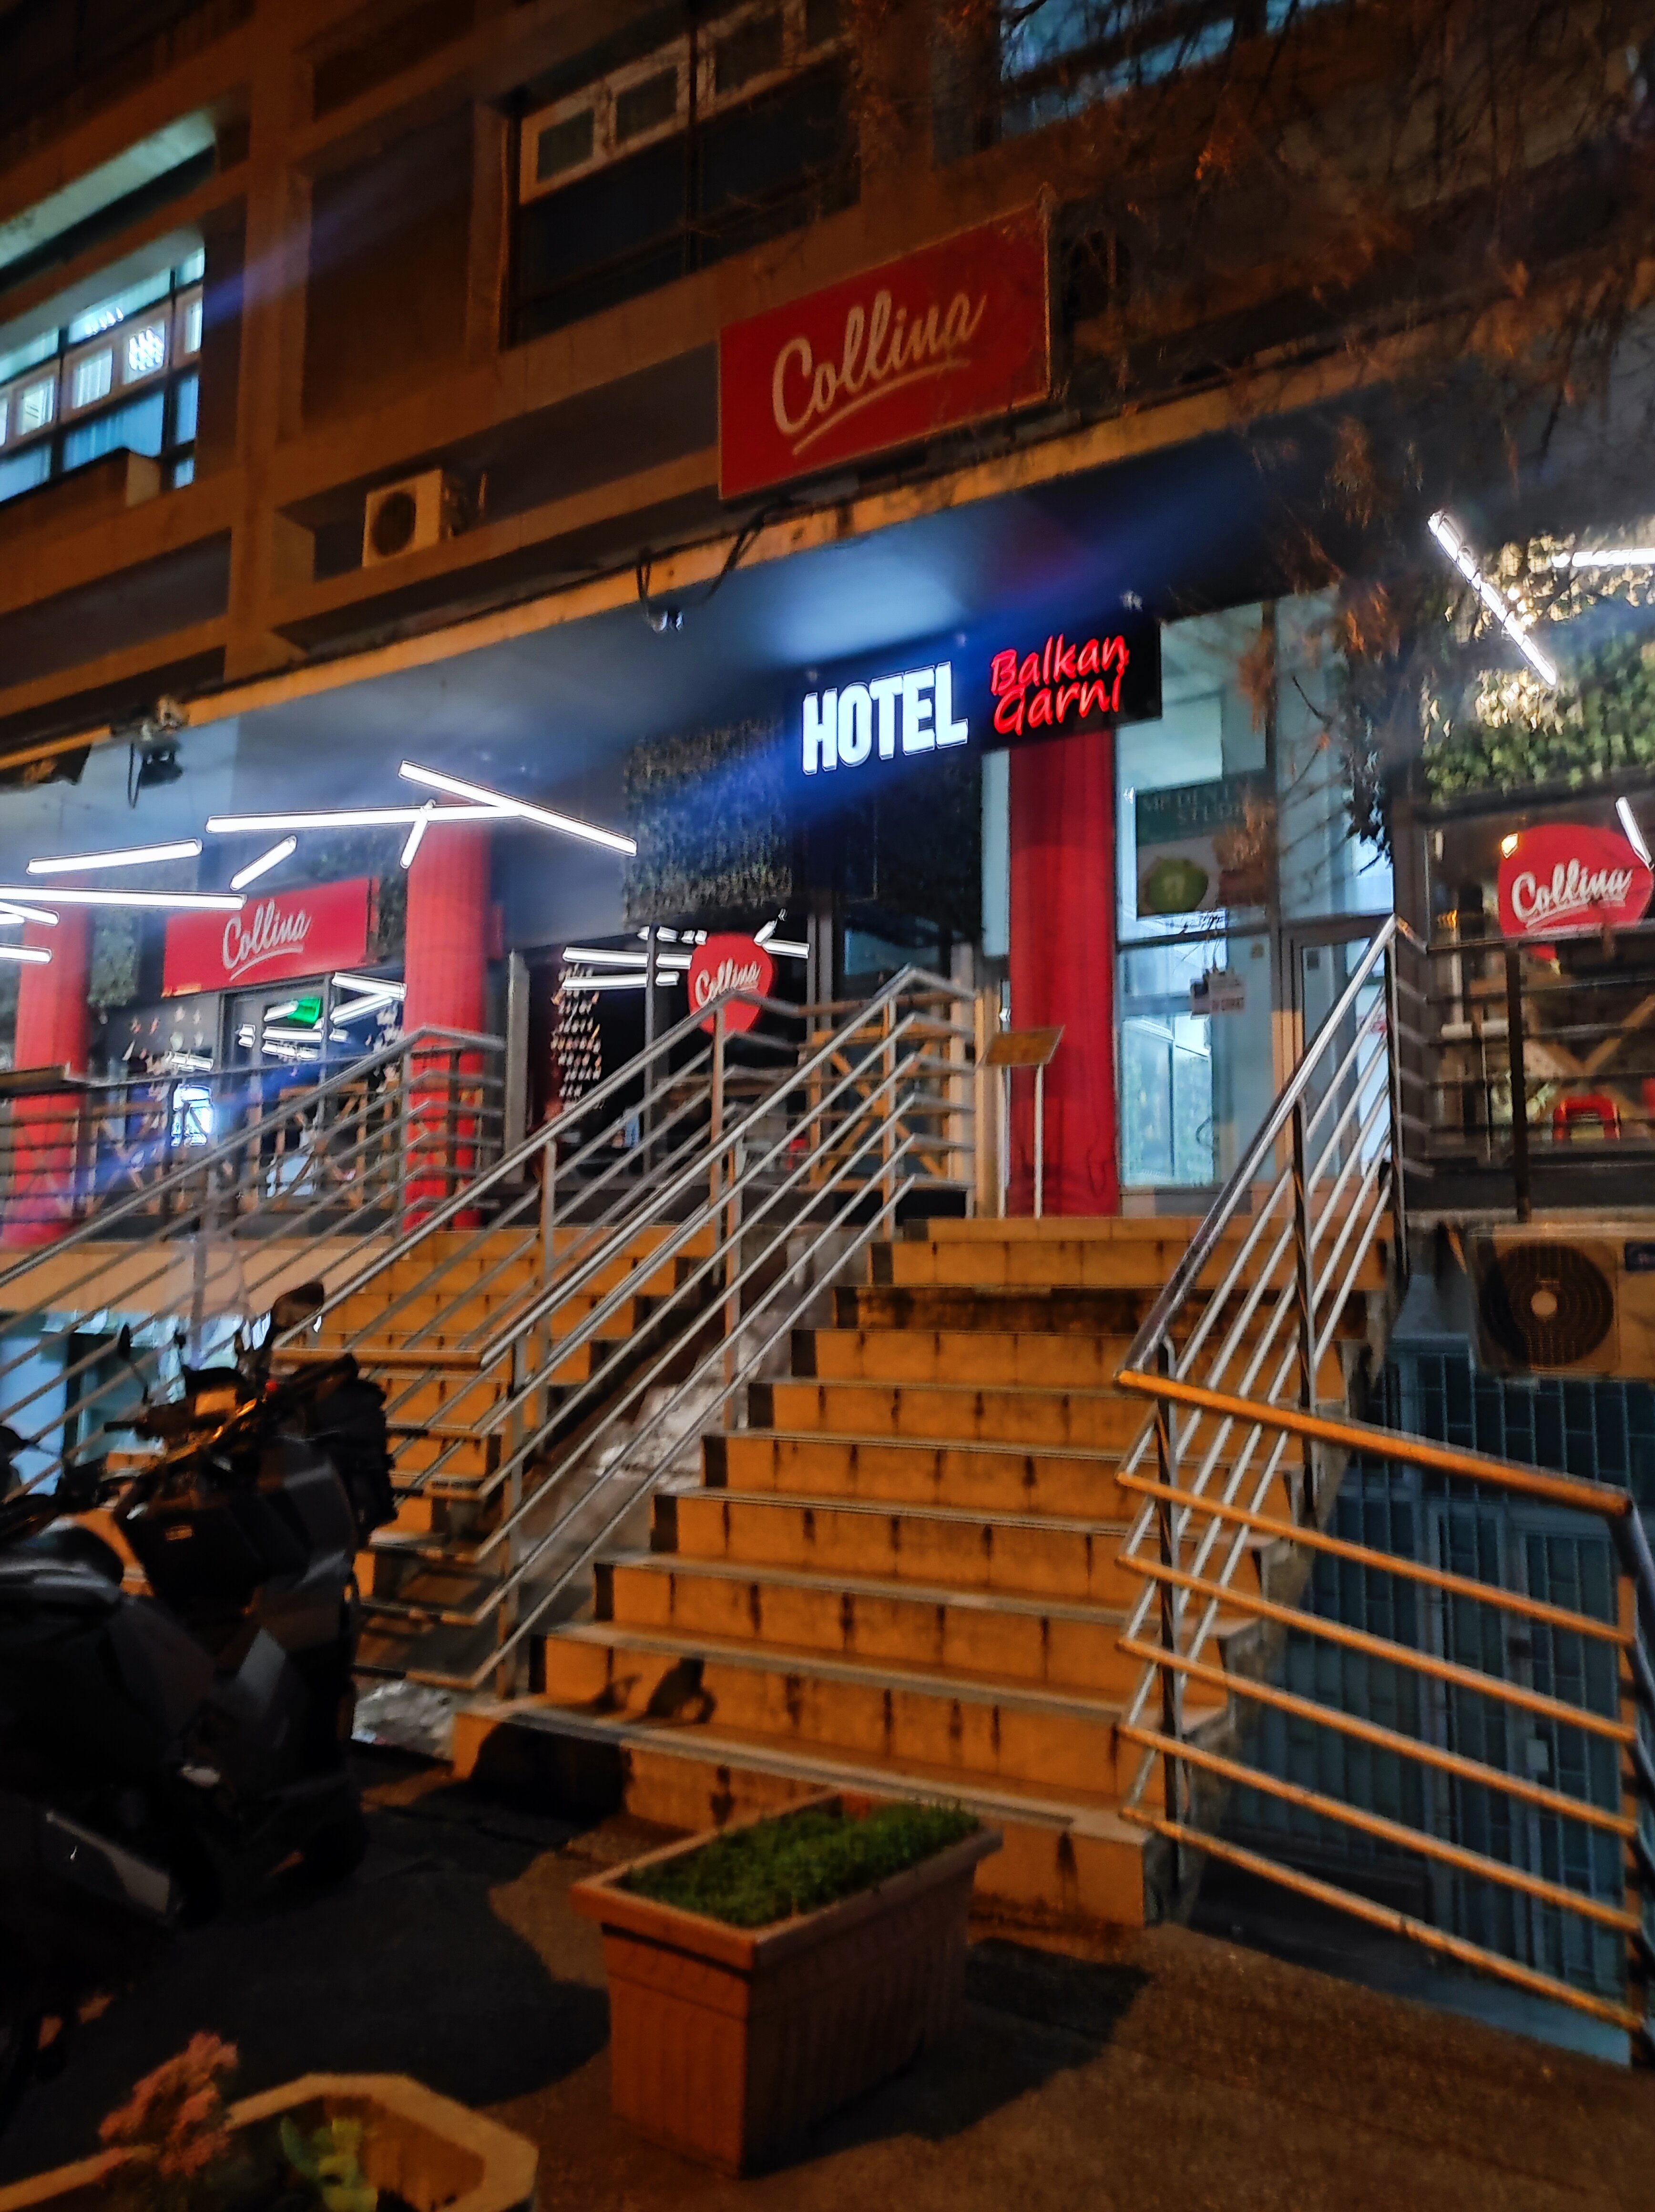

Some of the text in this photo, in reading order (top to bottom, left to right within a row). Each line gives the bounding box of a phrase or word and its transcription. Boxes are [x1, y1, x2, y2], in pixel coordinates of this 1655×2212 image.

[772, 288, 988, 435] Collina
[991, 633, 1130, 696] Balkan
[802, 661, 969, 776] HOTEL
[994, 664, 1124, 736] Garni
[1512, 858, 1633, 923] Collina
[222, 899, 311, 969] Collina
[695, 957, 762, 1008] Collina
